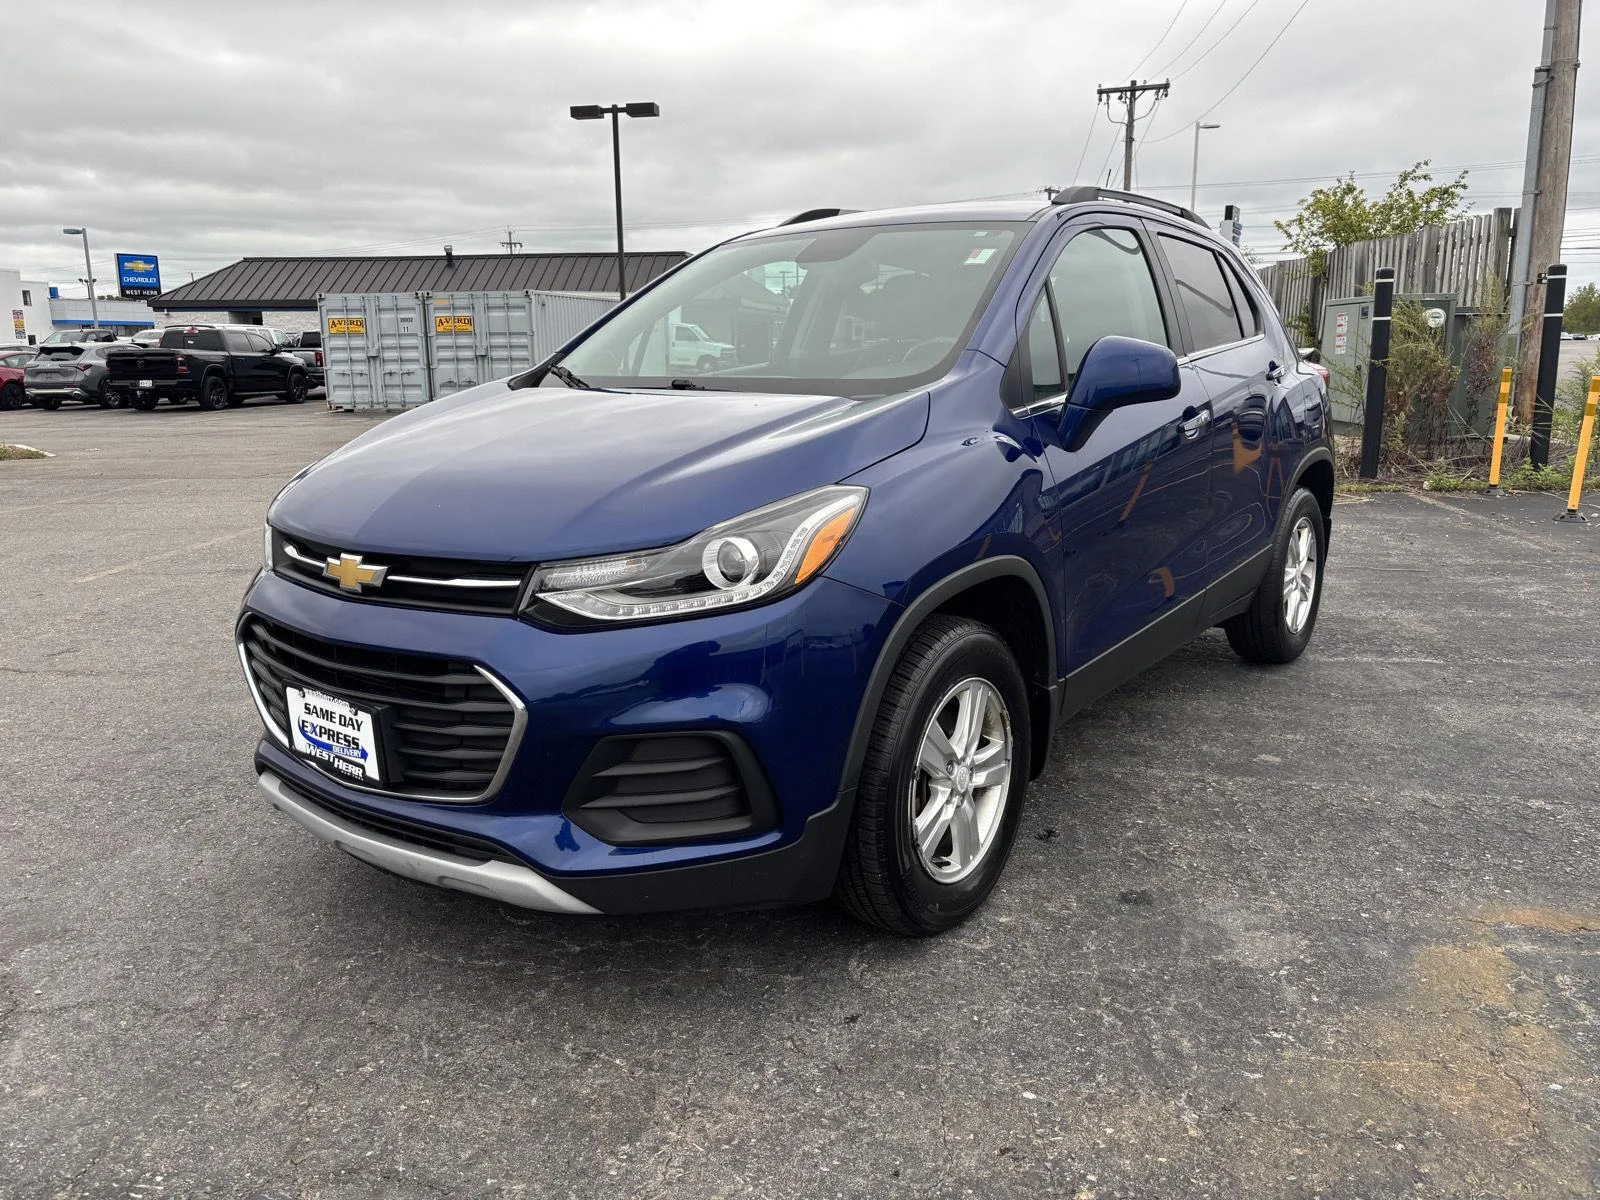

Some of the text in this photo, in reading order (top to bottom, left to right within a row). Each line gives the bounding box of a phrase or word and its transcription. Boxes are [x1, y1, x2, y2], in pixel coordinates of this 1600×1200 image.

[123, 276, 157, 284] CHEVROLET
[304, 702, 363, 732] SAME DAY
[301, 719, 360, 750] EXPRESS
[305, 743, 336, 762] WEST
[334, 758, 363, 776] HERR
[332, 745, 361, 758] DELIVERY
